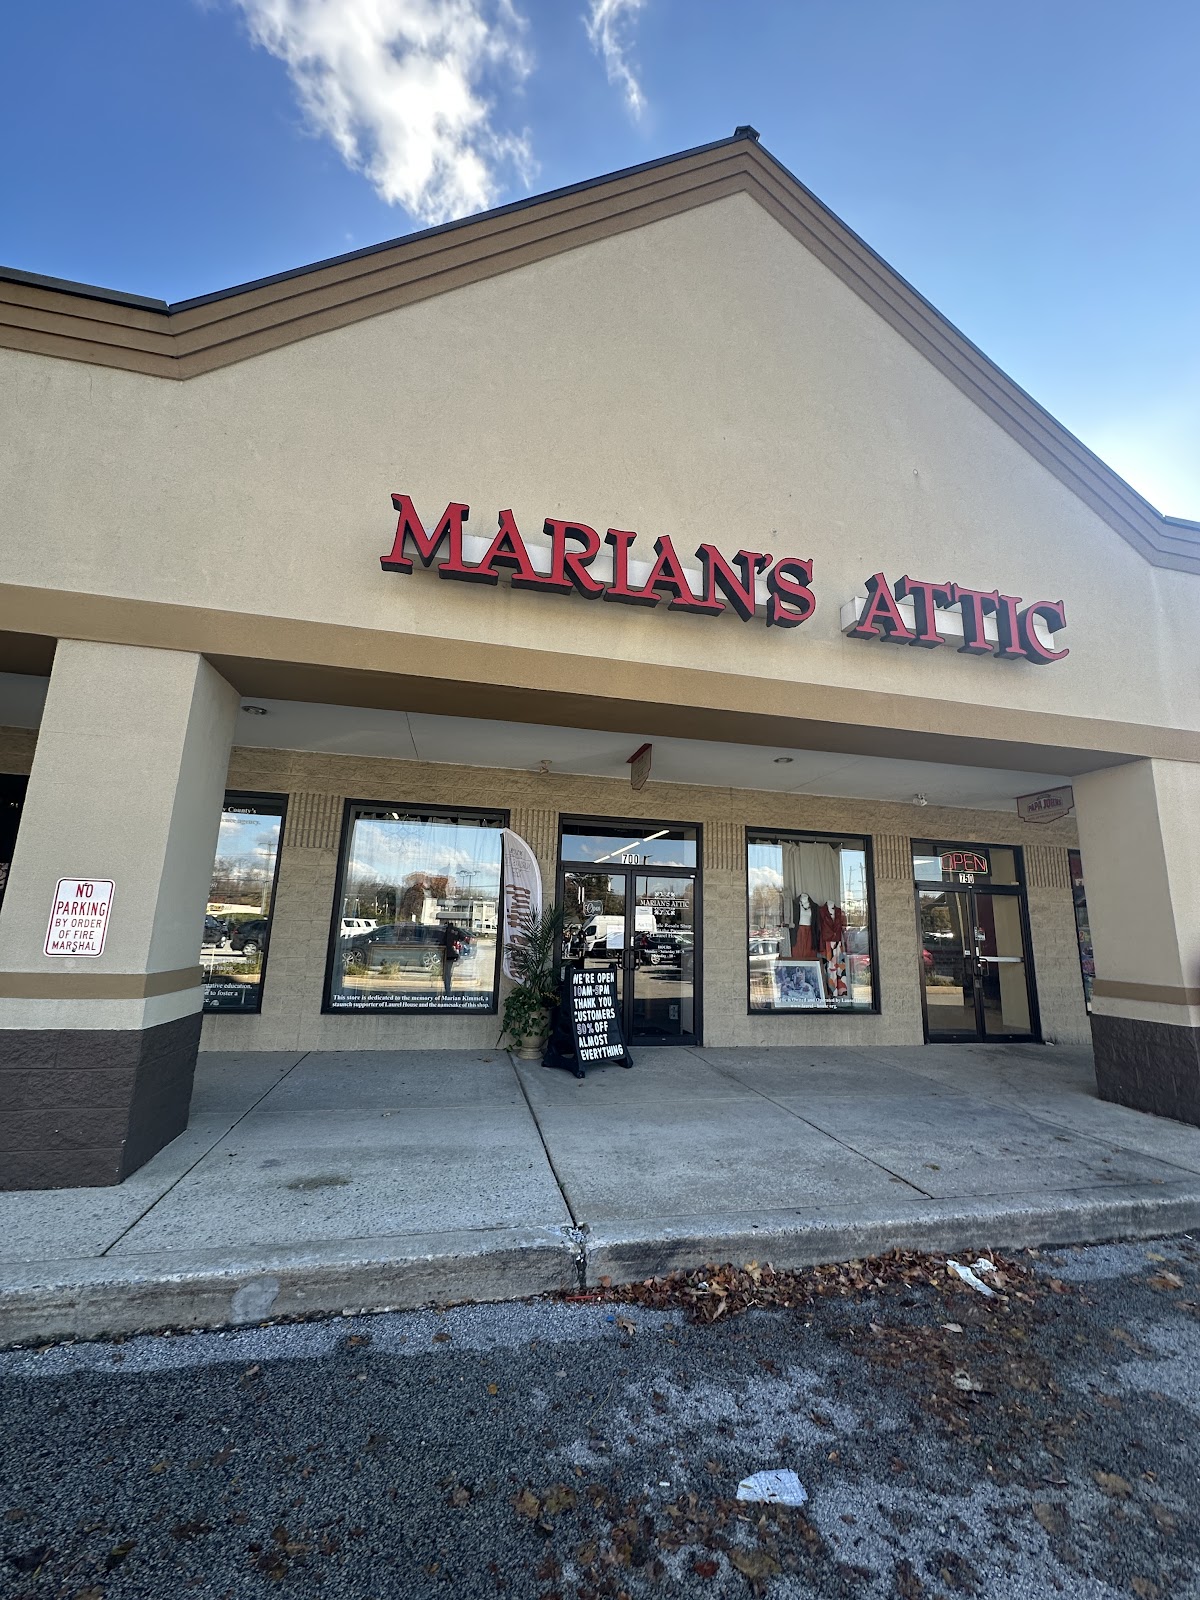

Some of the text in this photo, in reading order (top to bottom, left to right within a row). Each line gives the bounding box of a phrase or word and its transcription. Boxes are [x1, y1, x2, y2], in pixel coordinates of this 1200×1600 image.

[381, 493, 1069, 665] MARIAN'S ATTIC
[622, 854, 640, 865] 700
[942, 853, 986, 871] OPEN
[76, 883, 94, 898] NO
[56, 901, 106, 916] PARKING
[671, 900, 690, 908] ATTIC
[55, 918, 102, 928] BY ORDER
[59, 930, 95, 940] OF FIRE
[52, 941, 96, 951] MARSHAL
[573, 972, 615, 984] WE'RE OPEN
[574, 996, 612, 1009] THANK YOU
[574, 1008, 615, 1022] CUSTOMERS
[577, 1021, 608, 1034] 50% OFF
[579, 1034, 608, 1048] ALMOST
[581, 1044, 624, 1060] EVERYTHING
